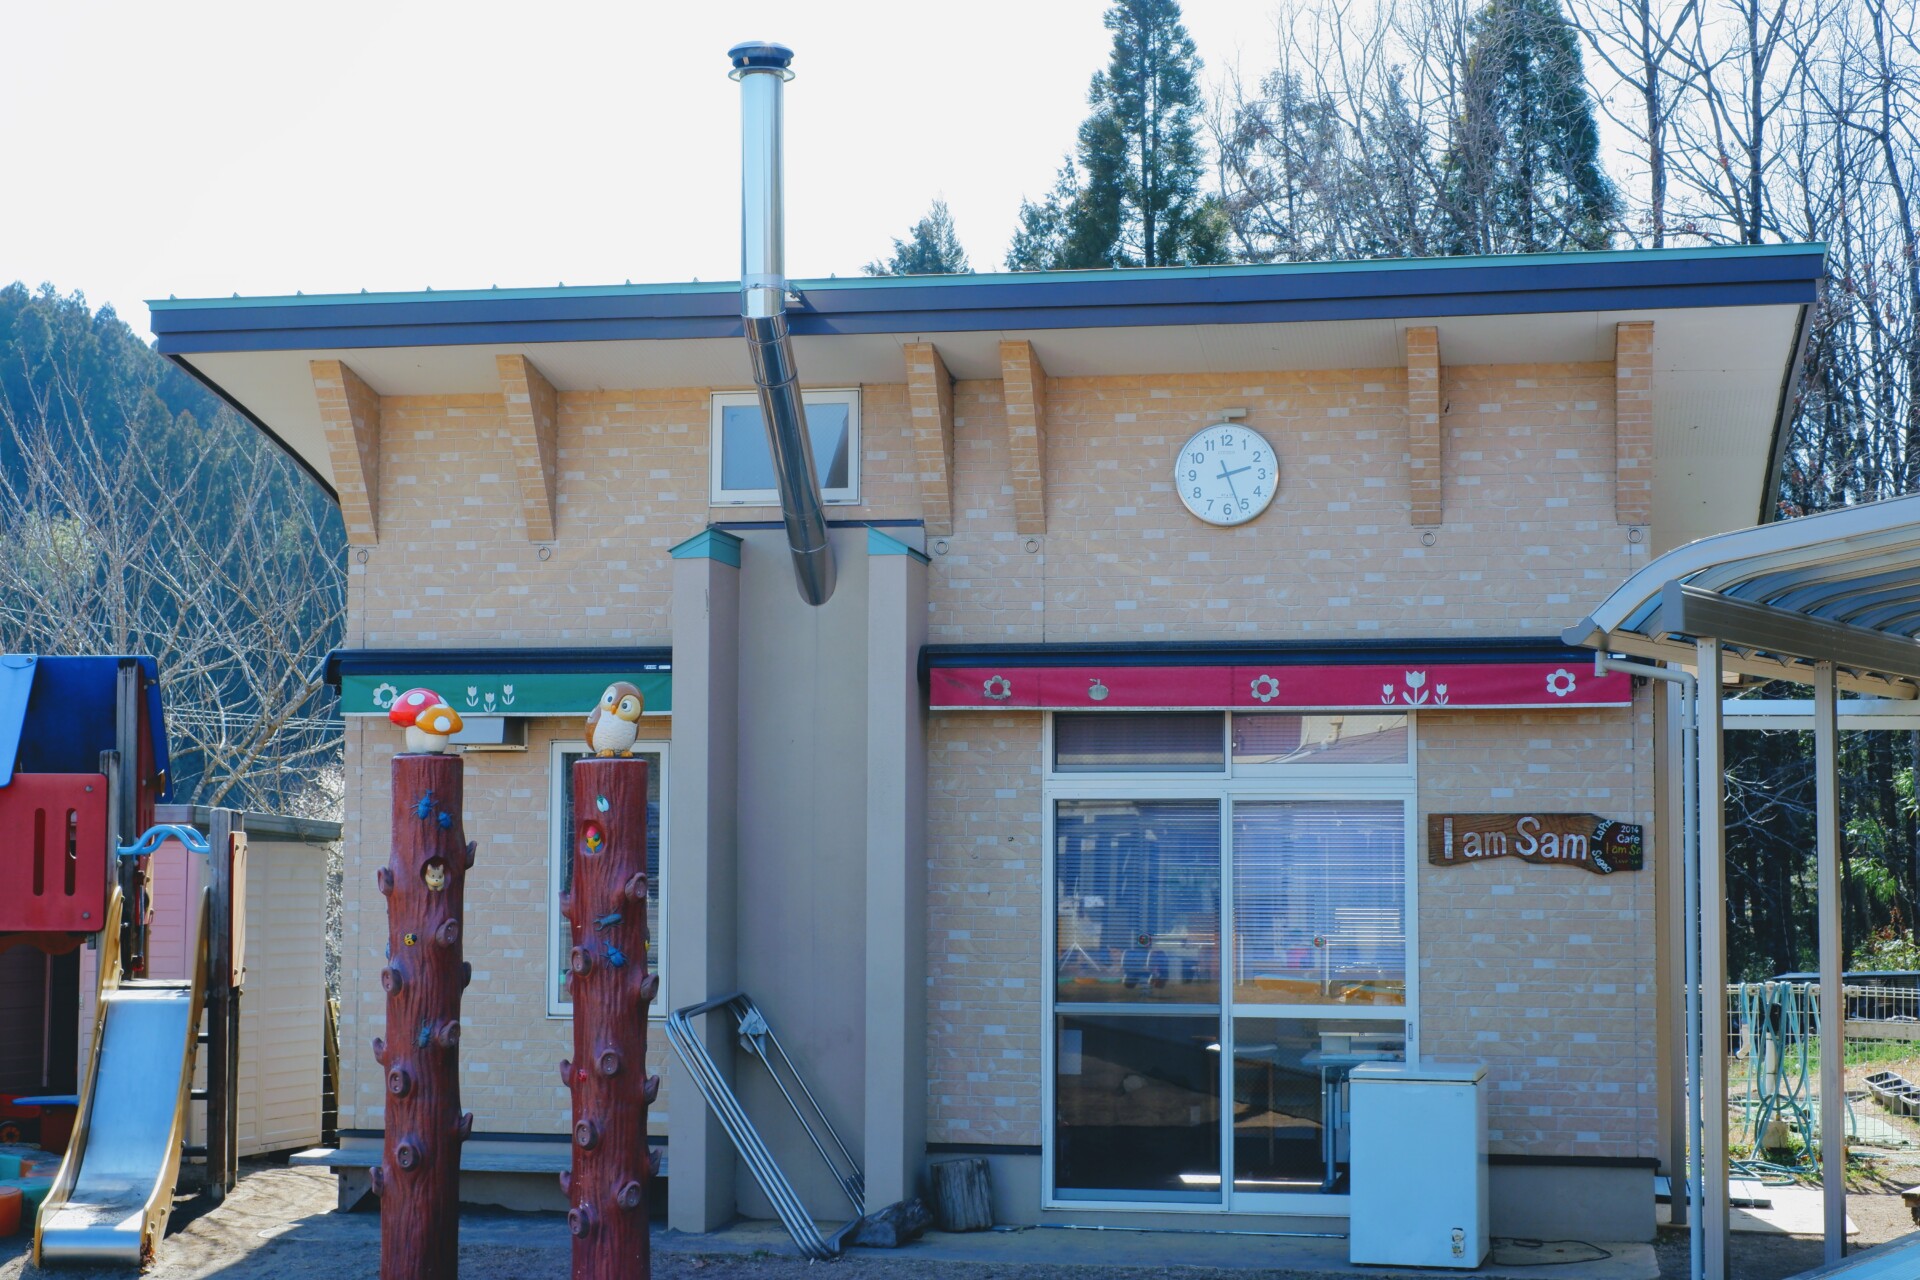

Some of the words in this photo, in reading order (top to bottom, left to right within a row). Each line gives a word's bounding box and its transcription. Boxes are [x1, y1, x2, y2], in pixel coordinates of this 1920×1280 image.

[1206, 440, 1214, 451] 11
[1220, 435, 1232, 446] 12
[1242, 439, 1246, 450] 1
[1191, 452, 1204, 464] 10
[1252, 452, 1261, 462] 2
[1188, 470, 1196, 482] 9
[1258, 468, 1266, 480] 3
[1193, 487, 1202, 498] 8
[1253, 486, 1262, 496] 4
[1206, 500, 1214, 511] 7
[1224, 504, 1232, 515] 6
[1240, 498, 1250, 510] 5
[1620, 825, 1639, 833] 2014
[1444, 817, 1453, 859] I
[1463, 831, 1506, 858] am
[1516, 816, 1587, 860] Sam
[1617, 834, 1640, 844] Cafe
[1612, 846, 1626, 854] am
